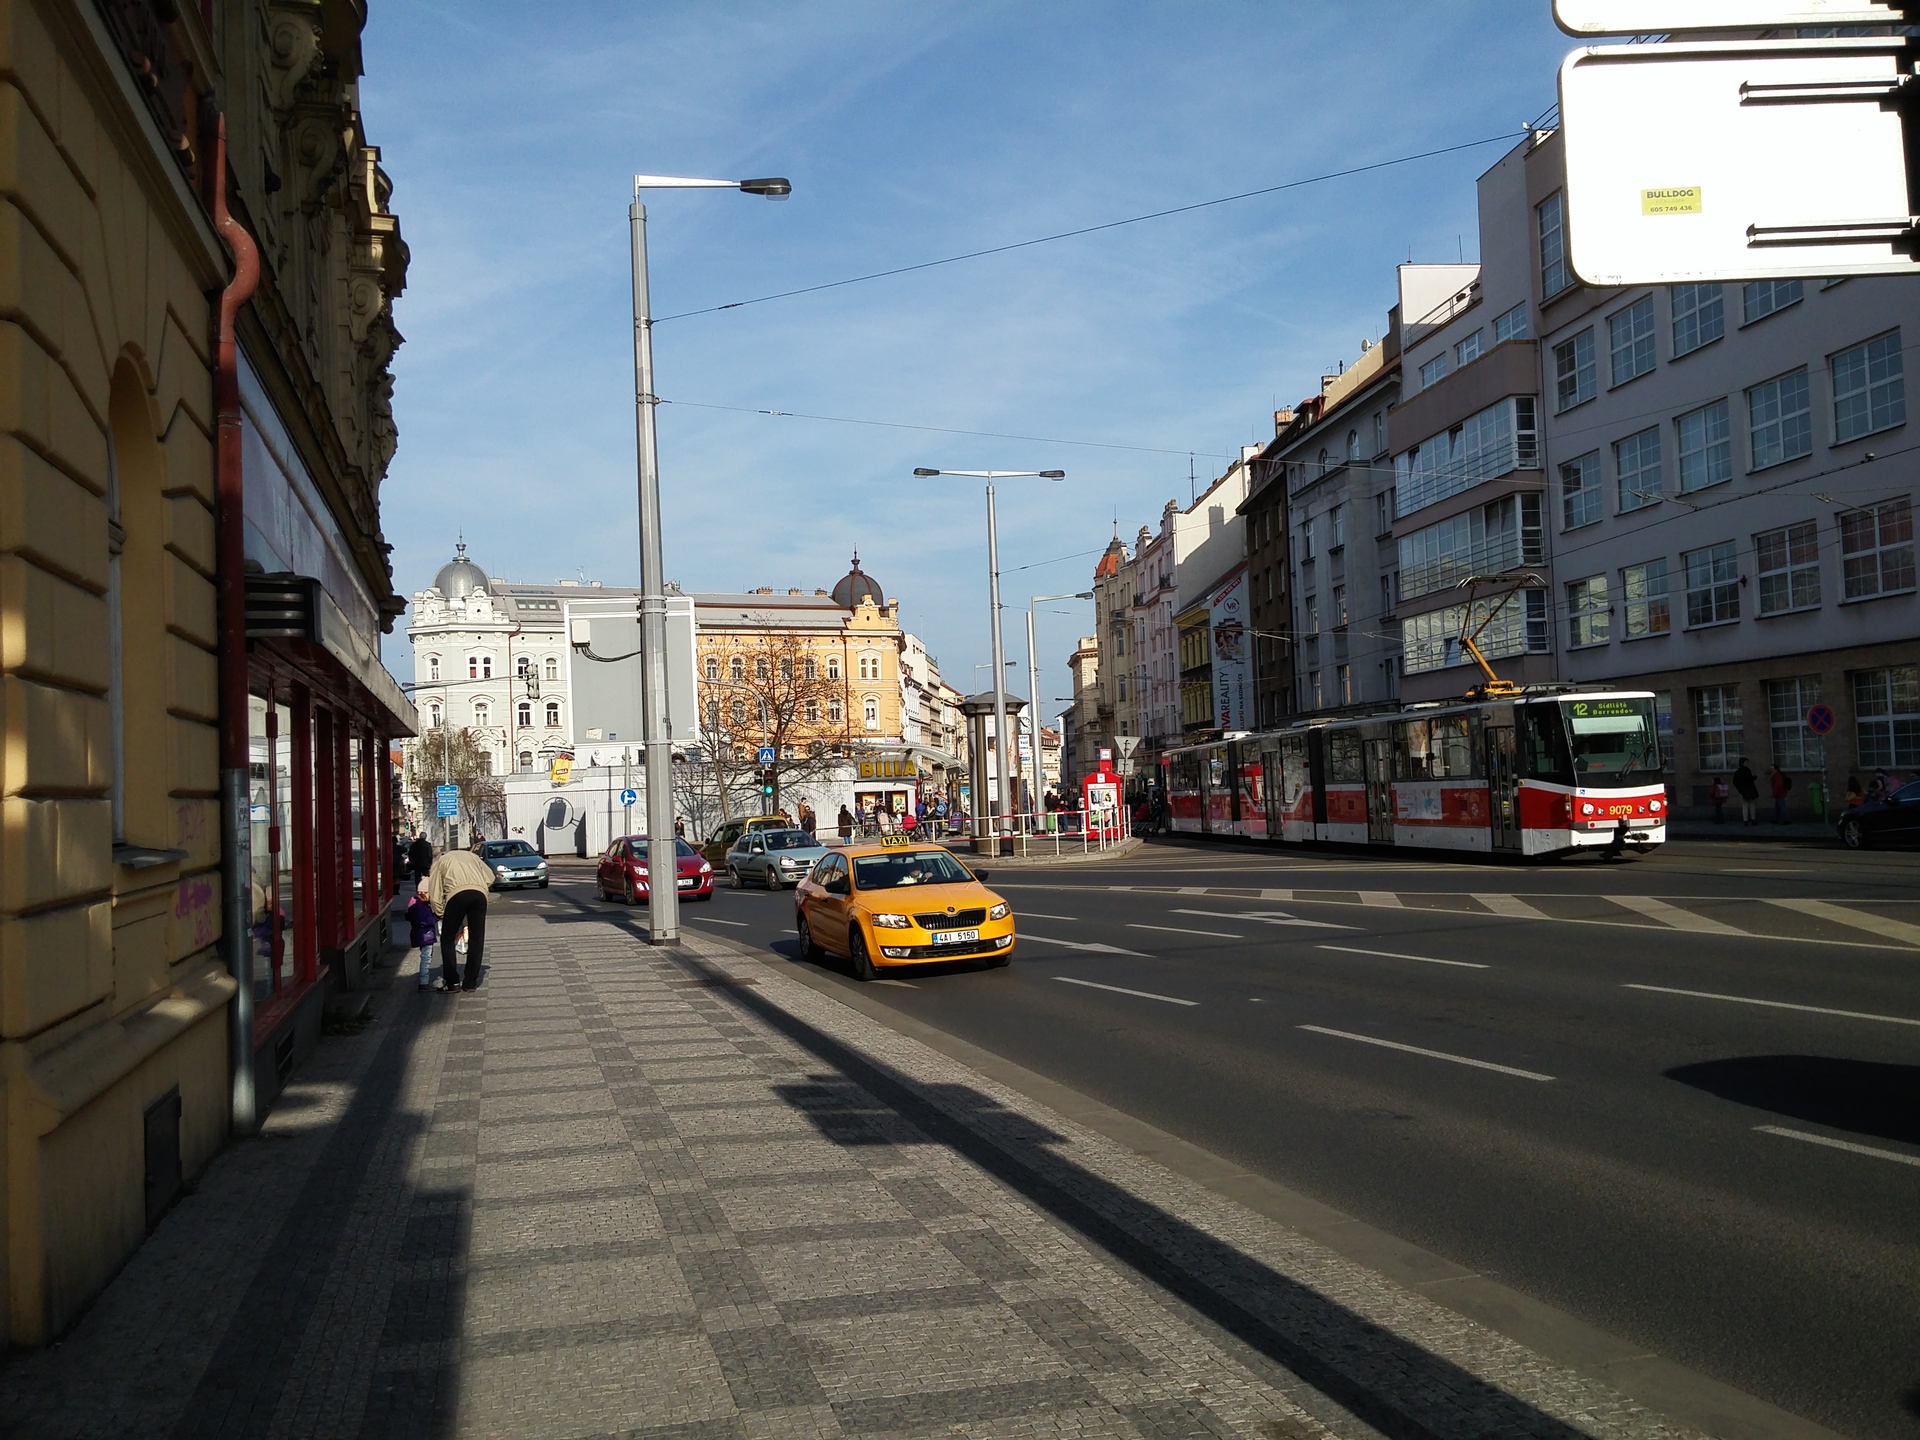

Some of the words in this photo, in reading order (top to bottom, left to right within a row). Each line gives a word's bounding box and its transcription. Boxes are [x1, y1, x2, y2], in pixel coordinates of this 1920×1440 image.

[1646, 189, 1694, 199] BULLDOG
[1573, 703, 1588, 716] 12
[1592, 708, 1634, 716] Barrandov
[860, 760, 917, 778] BILLA
[1609, 804, 1633, 815] 9079
[885, 836, 908, 846] TAXI
[957, 930, 976, 940] 5150
